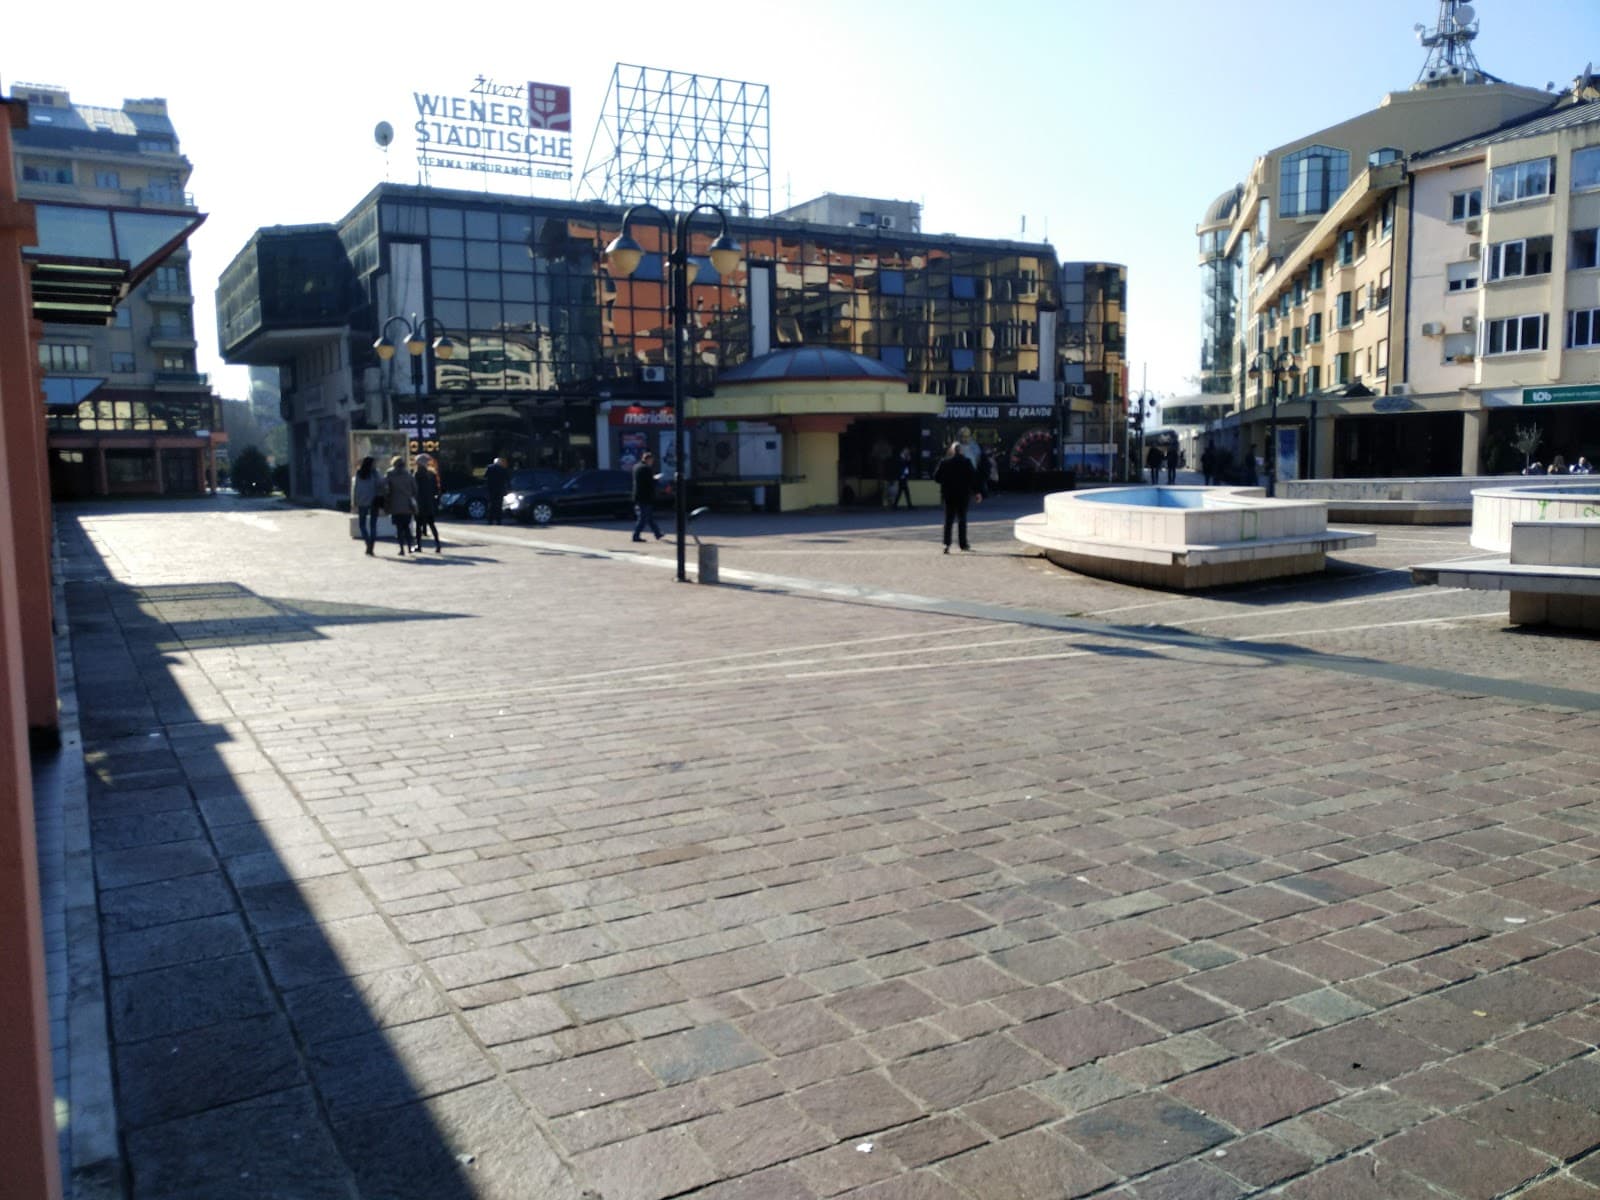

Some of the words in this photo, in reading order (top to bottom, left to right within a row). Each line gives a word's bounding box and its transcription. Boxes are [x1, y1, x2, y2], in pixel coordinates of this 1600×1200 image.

[413, 92, 523, 127] WIENER
[415, 120, 573, 160] STÄDTISCHE
[417, 156, 462, 169] VIENNA
[465, 161, 532, 176] INSURANCE
[977, 406, 1000, 418] KLUB
